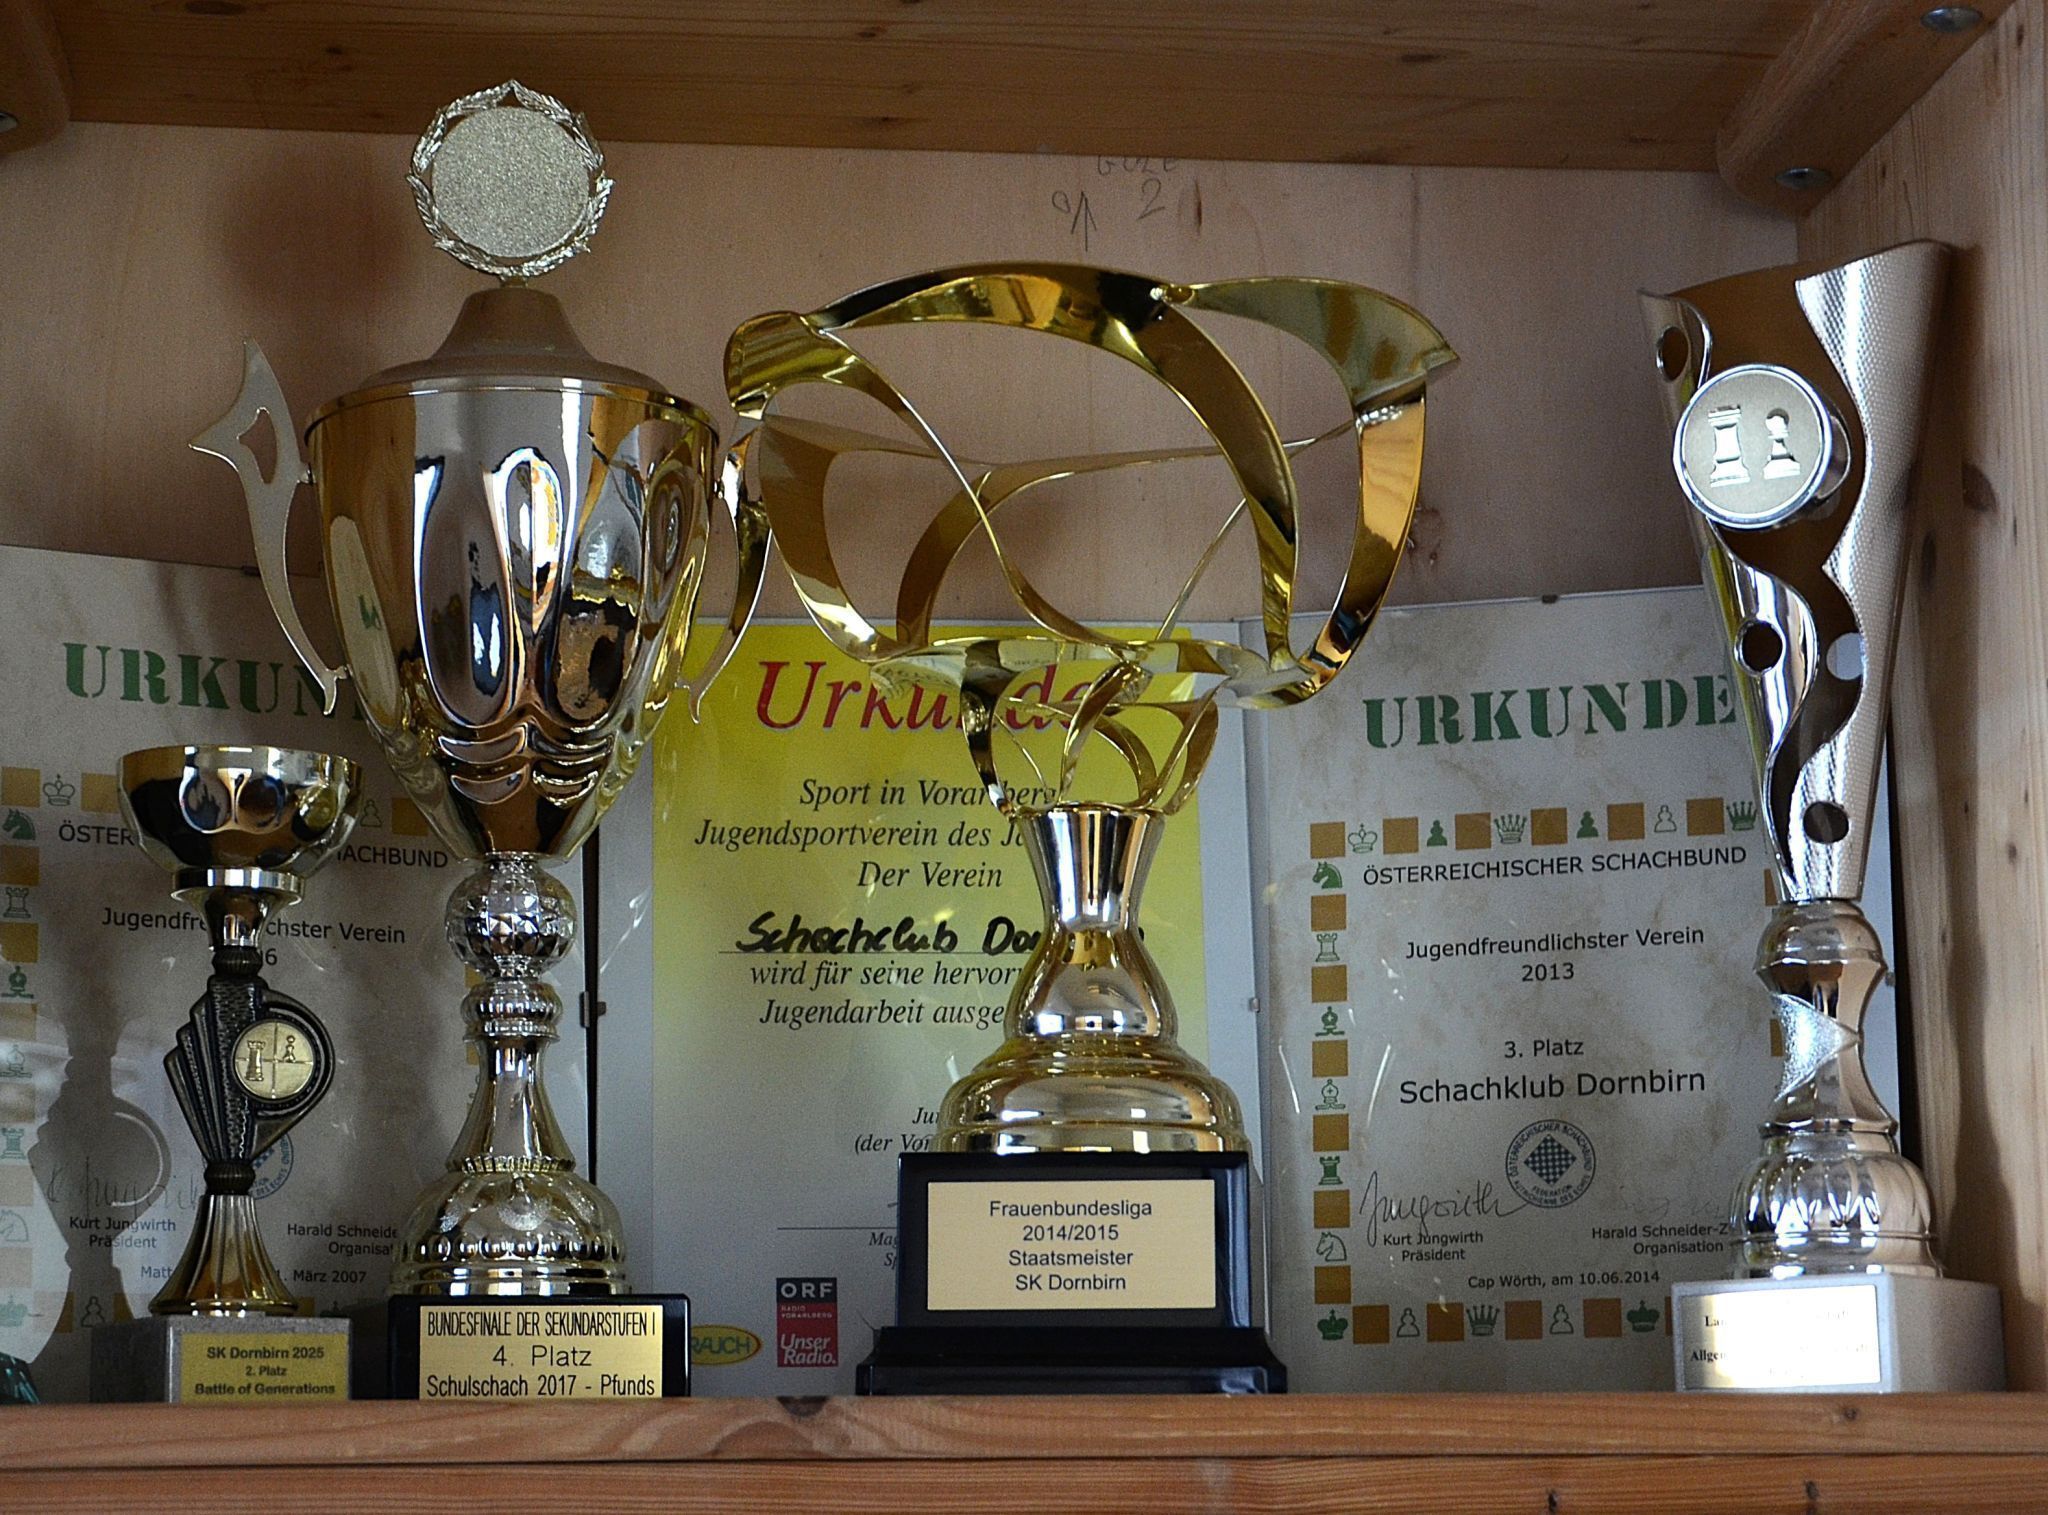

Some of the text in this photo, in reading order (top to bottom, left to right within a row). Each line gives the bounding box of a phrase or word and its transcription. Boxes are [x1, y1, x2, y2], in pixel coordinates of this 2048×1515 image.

[1362, 673, 1737, 750] URKUNDE
[800, 779, 870, 811] Sport
[880, 779, 905, 804] in
[695, 819, 938, 852] Jugendsportverein
[948, 821, 991, 846] des
[337, 845, 449, 869] ACHBUND
[1363, 846, 1747, 885] ÖSTERREICHISCHER SCHACHBUND
[857, 861, 1003, 887] Der Verein
[339, 922, 405, 944] Verein
[1405, 927, 1704, 960] Jugendfreundlichster Verein
[750, 960, 807, 985] wird
[811, 960, 852, 991] für
[860, 961, 922, 985] seine
[1521, 962, 1575, 982] 2013
[760, 999, 924, 1030] Jugendarbeit
[1503, 1038, 1584, 1058] 3. Platz
[1400, 1069, 1706, 1104] Schachklub Dornbirn
[855, 1134, 893, 1155] (der
[990, 1200, 1152, 1219] Frauenbundesliga
[69, 1216, 176, 1233] Kurt Jungwirth
[287, 1223, 332, 1237] Harald
[1023, 1224, 1119, 1241] 2014/2015
[1592, 1226, 1637, 1239] Harald
[89, 1235, 157, 1249] Präsident
[1383, 1231, 1483, 1246] Kurt Jungwirth
[1008, 1249, 1133, 1266] Staatsmeister
[1402, 1248, 1466, 1262] Präsident
[1633, 1240, 1724, 1257] Organisation
[294, 1269, 326, 1282] März
[332, 1270, 366, 1283] 2007
[1015, 1273, 1126, 1290] SK Dornbirn
[1468, 1270, 1660, 1289] Cap Wörth, am 10.06.2014
[780, 1282, 833, 1298] ORF
[427, 1311, 511, 1336] BUNDESFINALE
[517, 1311, 540, 1336] DER
[545, 1311, 647, 1336] SEKUNDARSTUFEN
[780, 1333, 831, 1350] Unser
[206, 1346, 324, 1359] SK Dornbirn 2025
[492, 1344, 592, 1367] 4. Platz
[784, 1350, 837, 1365] Radio.
[245, 1366, 287, 1377] 2. Platz
[195, 1383, 335, 1395] Battle of Generations
[427, 1374, 528, 1397] Schulschach
[537, 1375, 577, 1396] 2017
[601, 1374, 655, 1396] Pfunds
